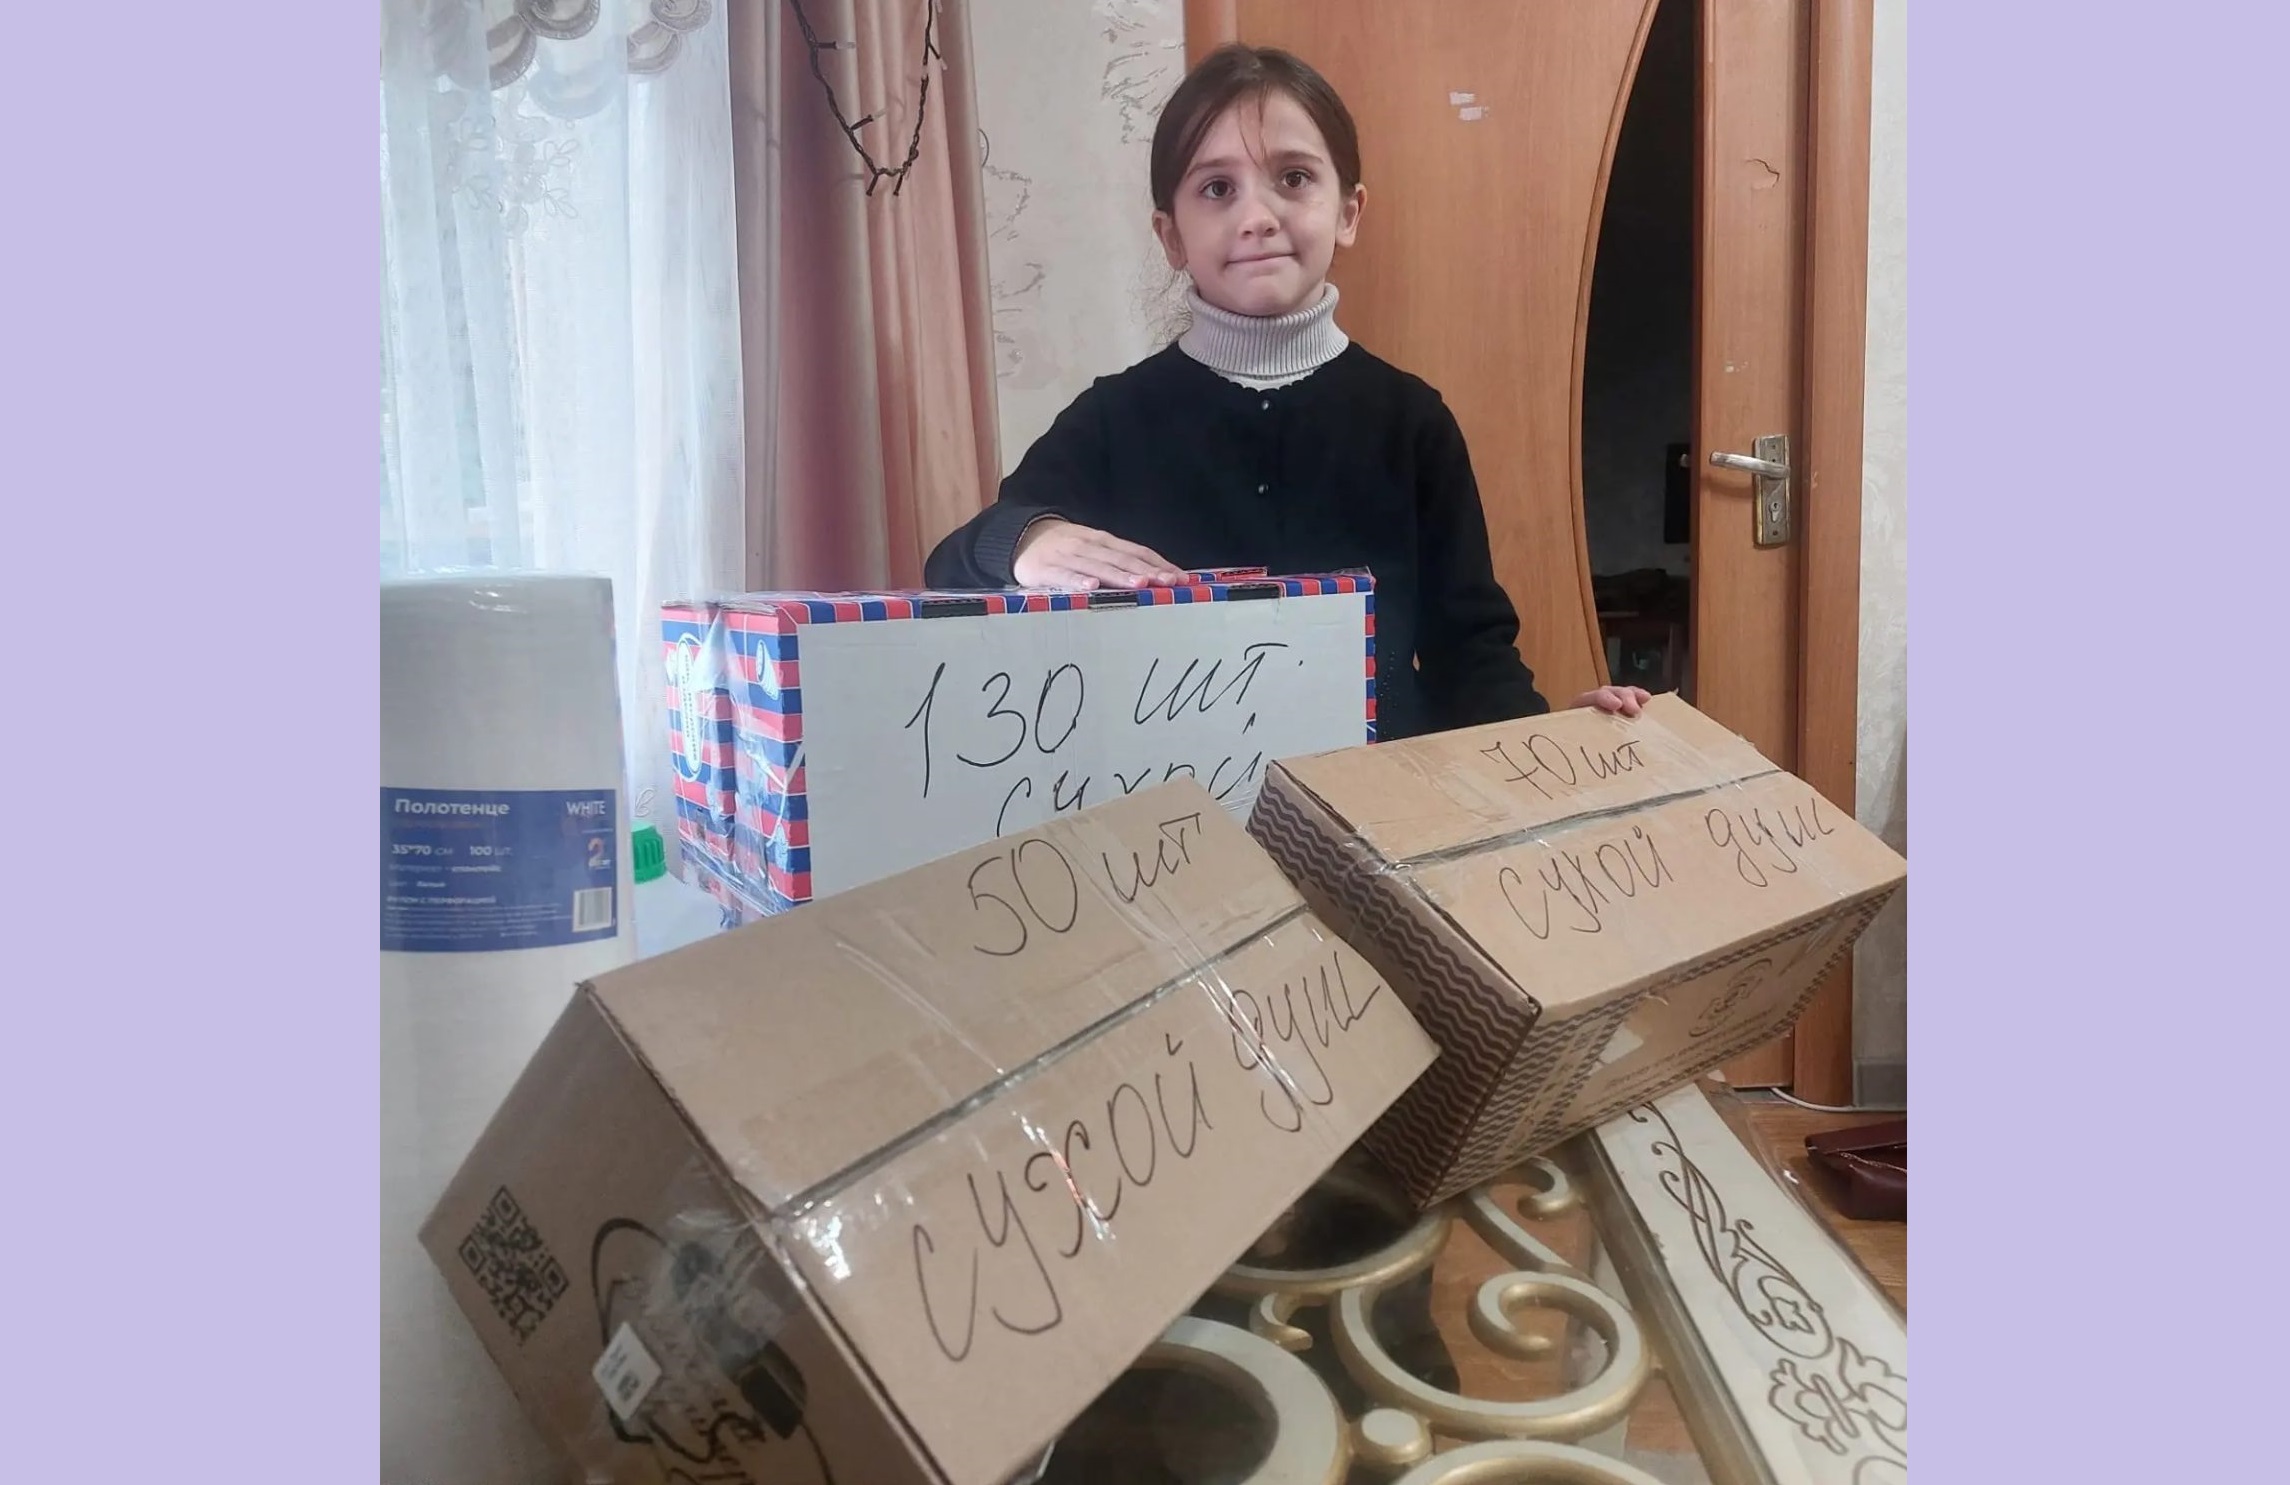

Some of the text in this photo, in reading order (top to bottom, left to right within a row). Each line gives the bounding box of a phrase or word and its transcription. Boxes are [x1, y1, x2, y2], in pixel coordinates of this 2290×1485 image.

[903, 659, 1085, 799] 130
[1480, 733, 1578, 801] 70
[394, 799, 510, 816] Полотенце
[565, 801, 606, 816] WHITE
[469, 846, 493, 856] 100
[966, 838, 1079, 956] 50
